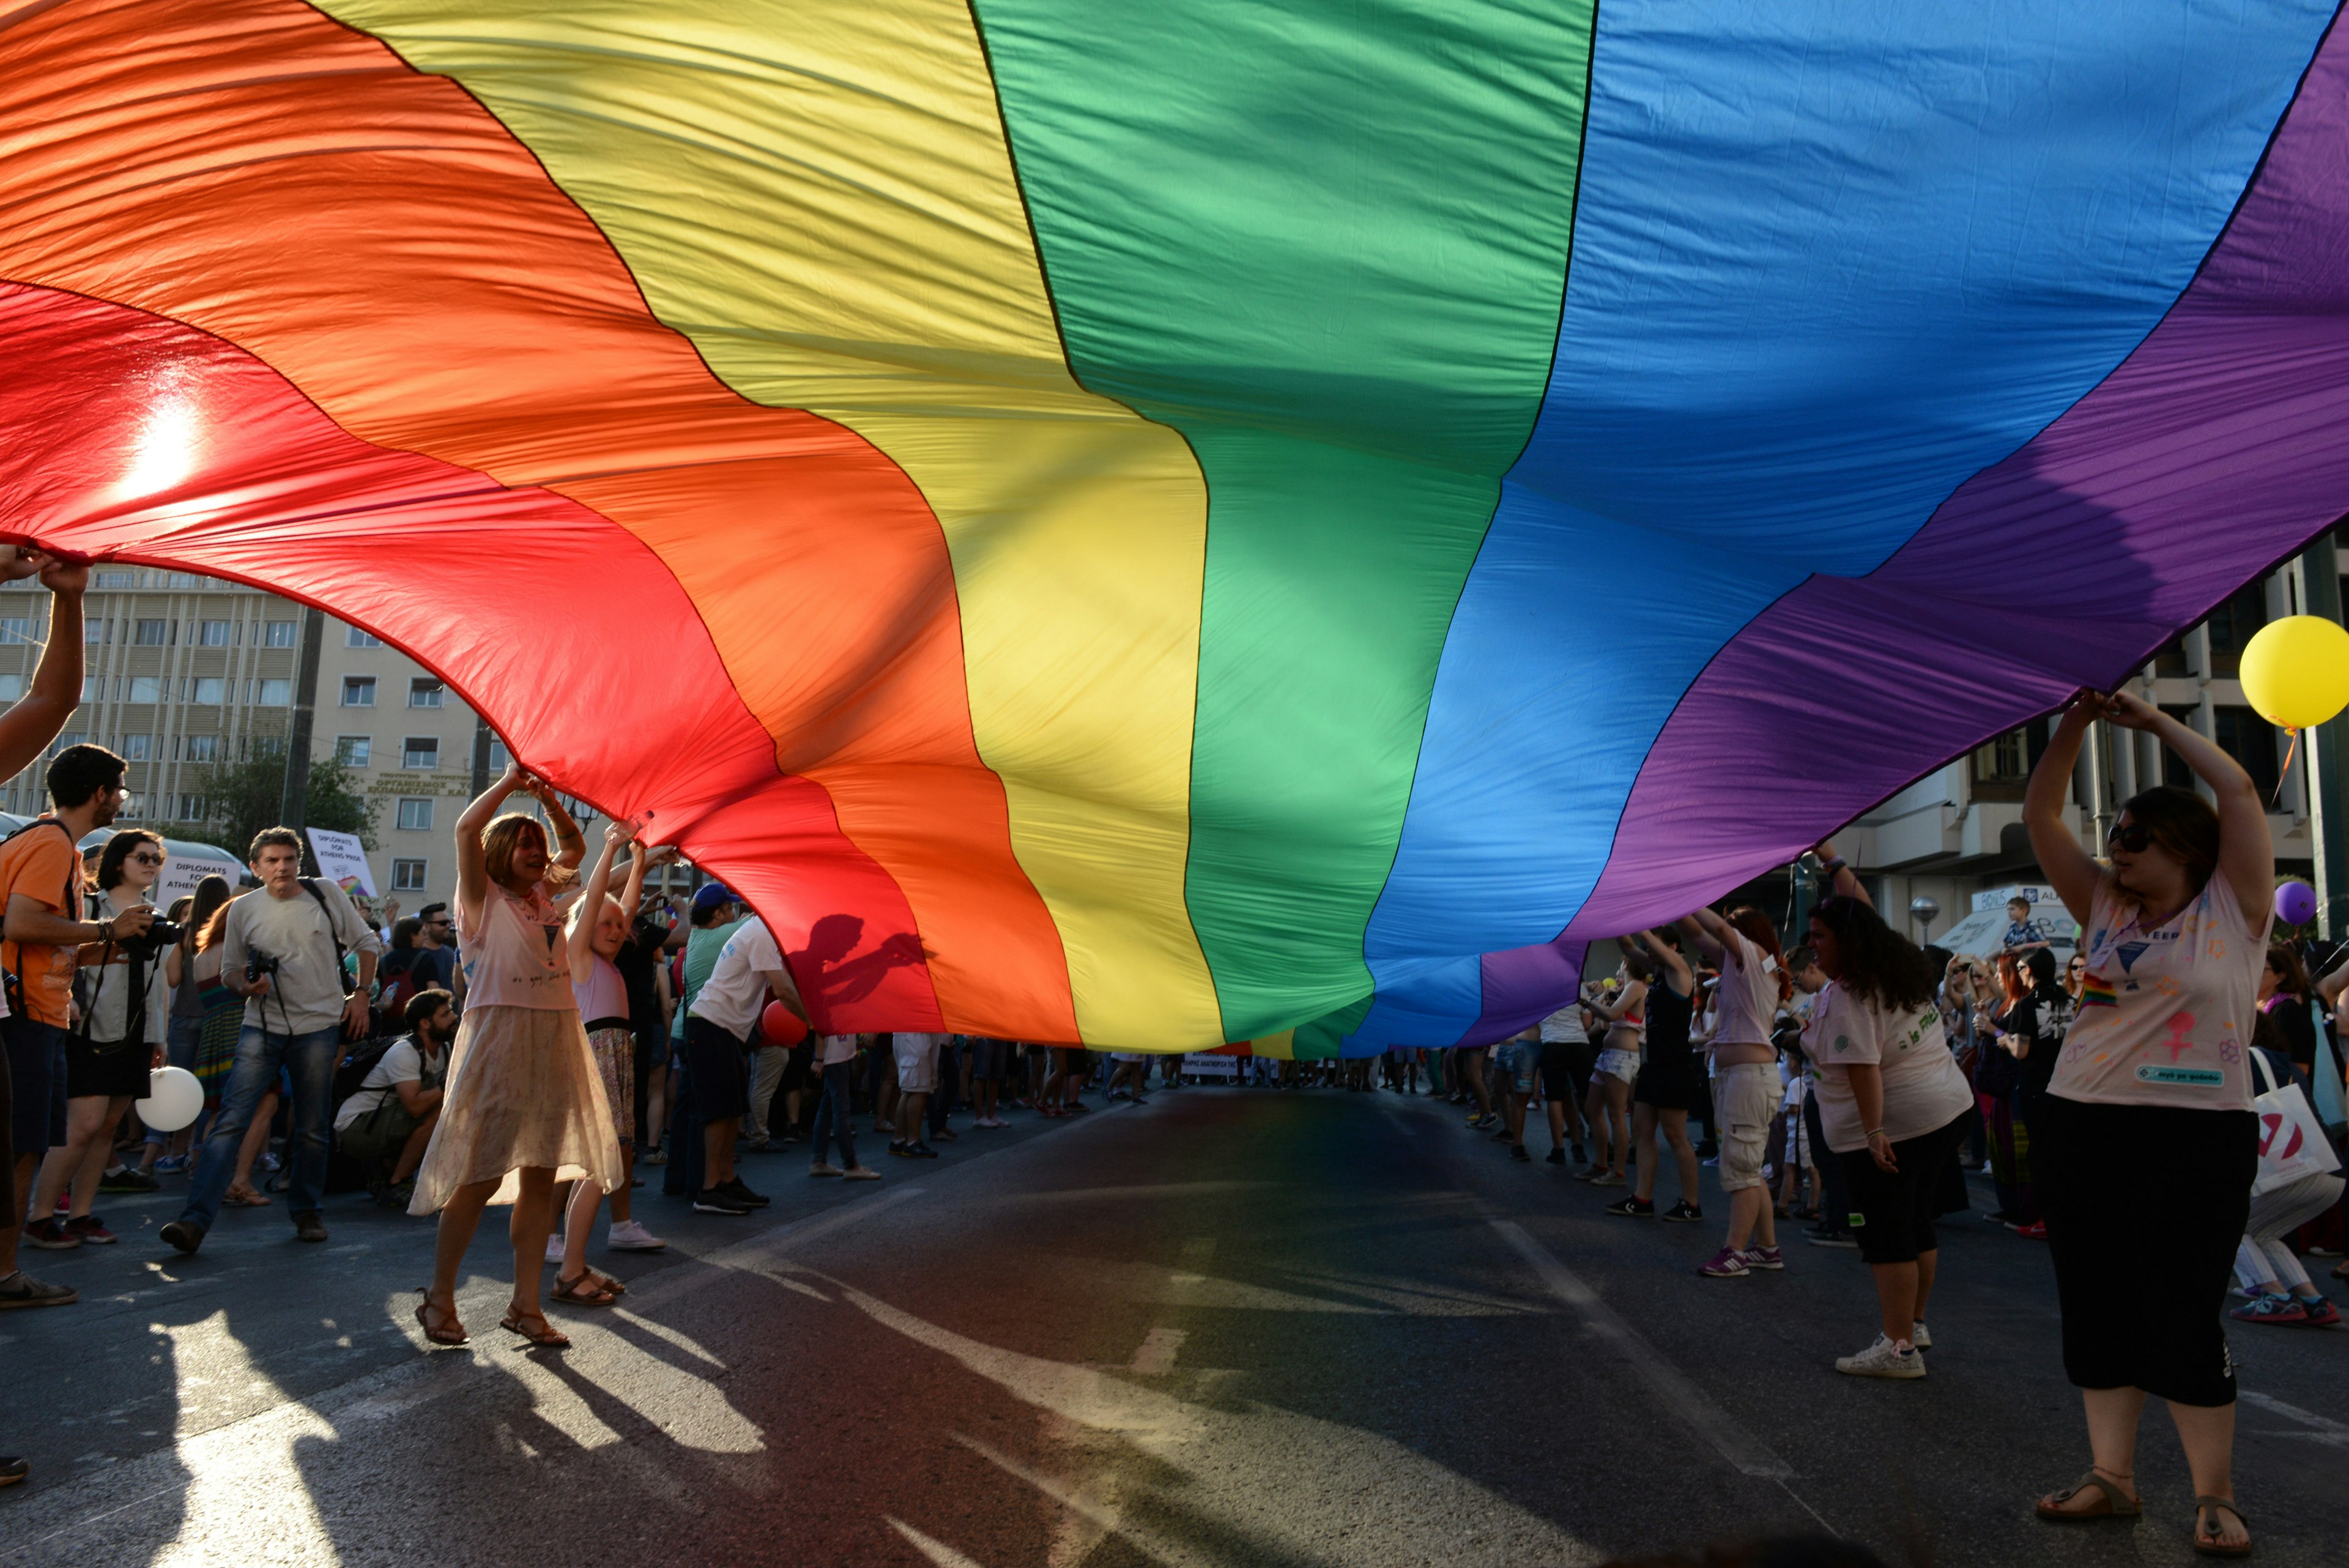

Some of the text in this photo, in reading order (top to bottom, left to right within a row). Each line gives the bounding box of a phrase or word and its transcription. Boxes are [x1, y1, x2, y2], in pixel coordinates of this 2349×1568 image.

[376, 779, 447, 789] ΟΡΓΑΝΙΣΜΟΣ
[176, 863, 227, 875] DIPLOMATS
[166, 881, 197, 890] ATHEN
